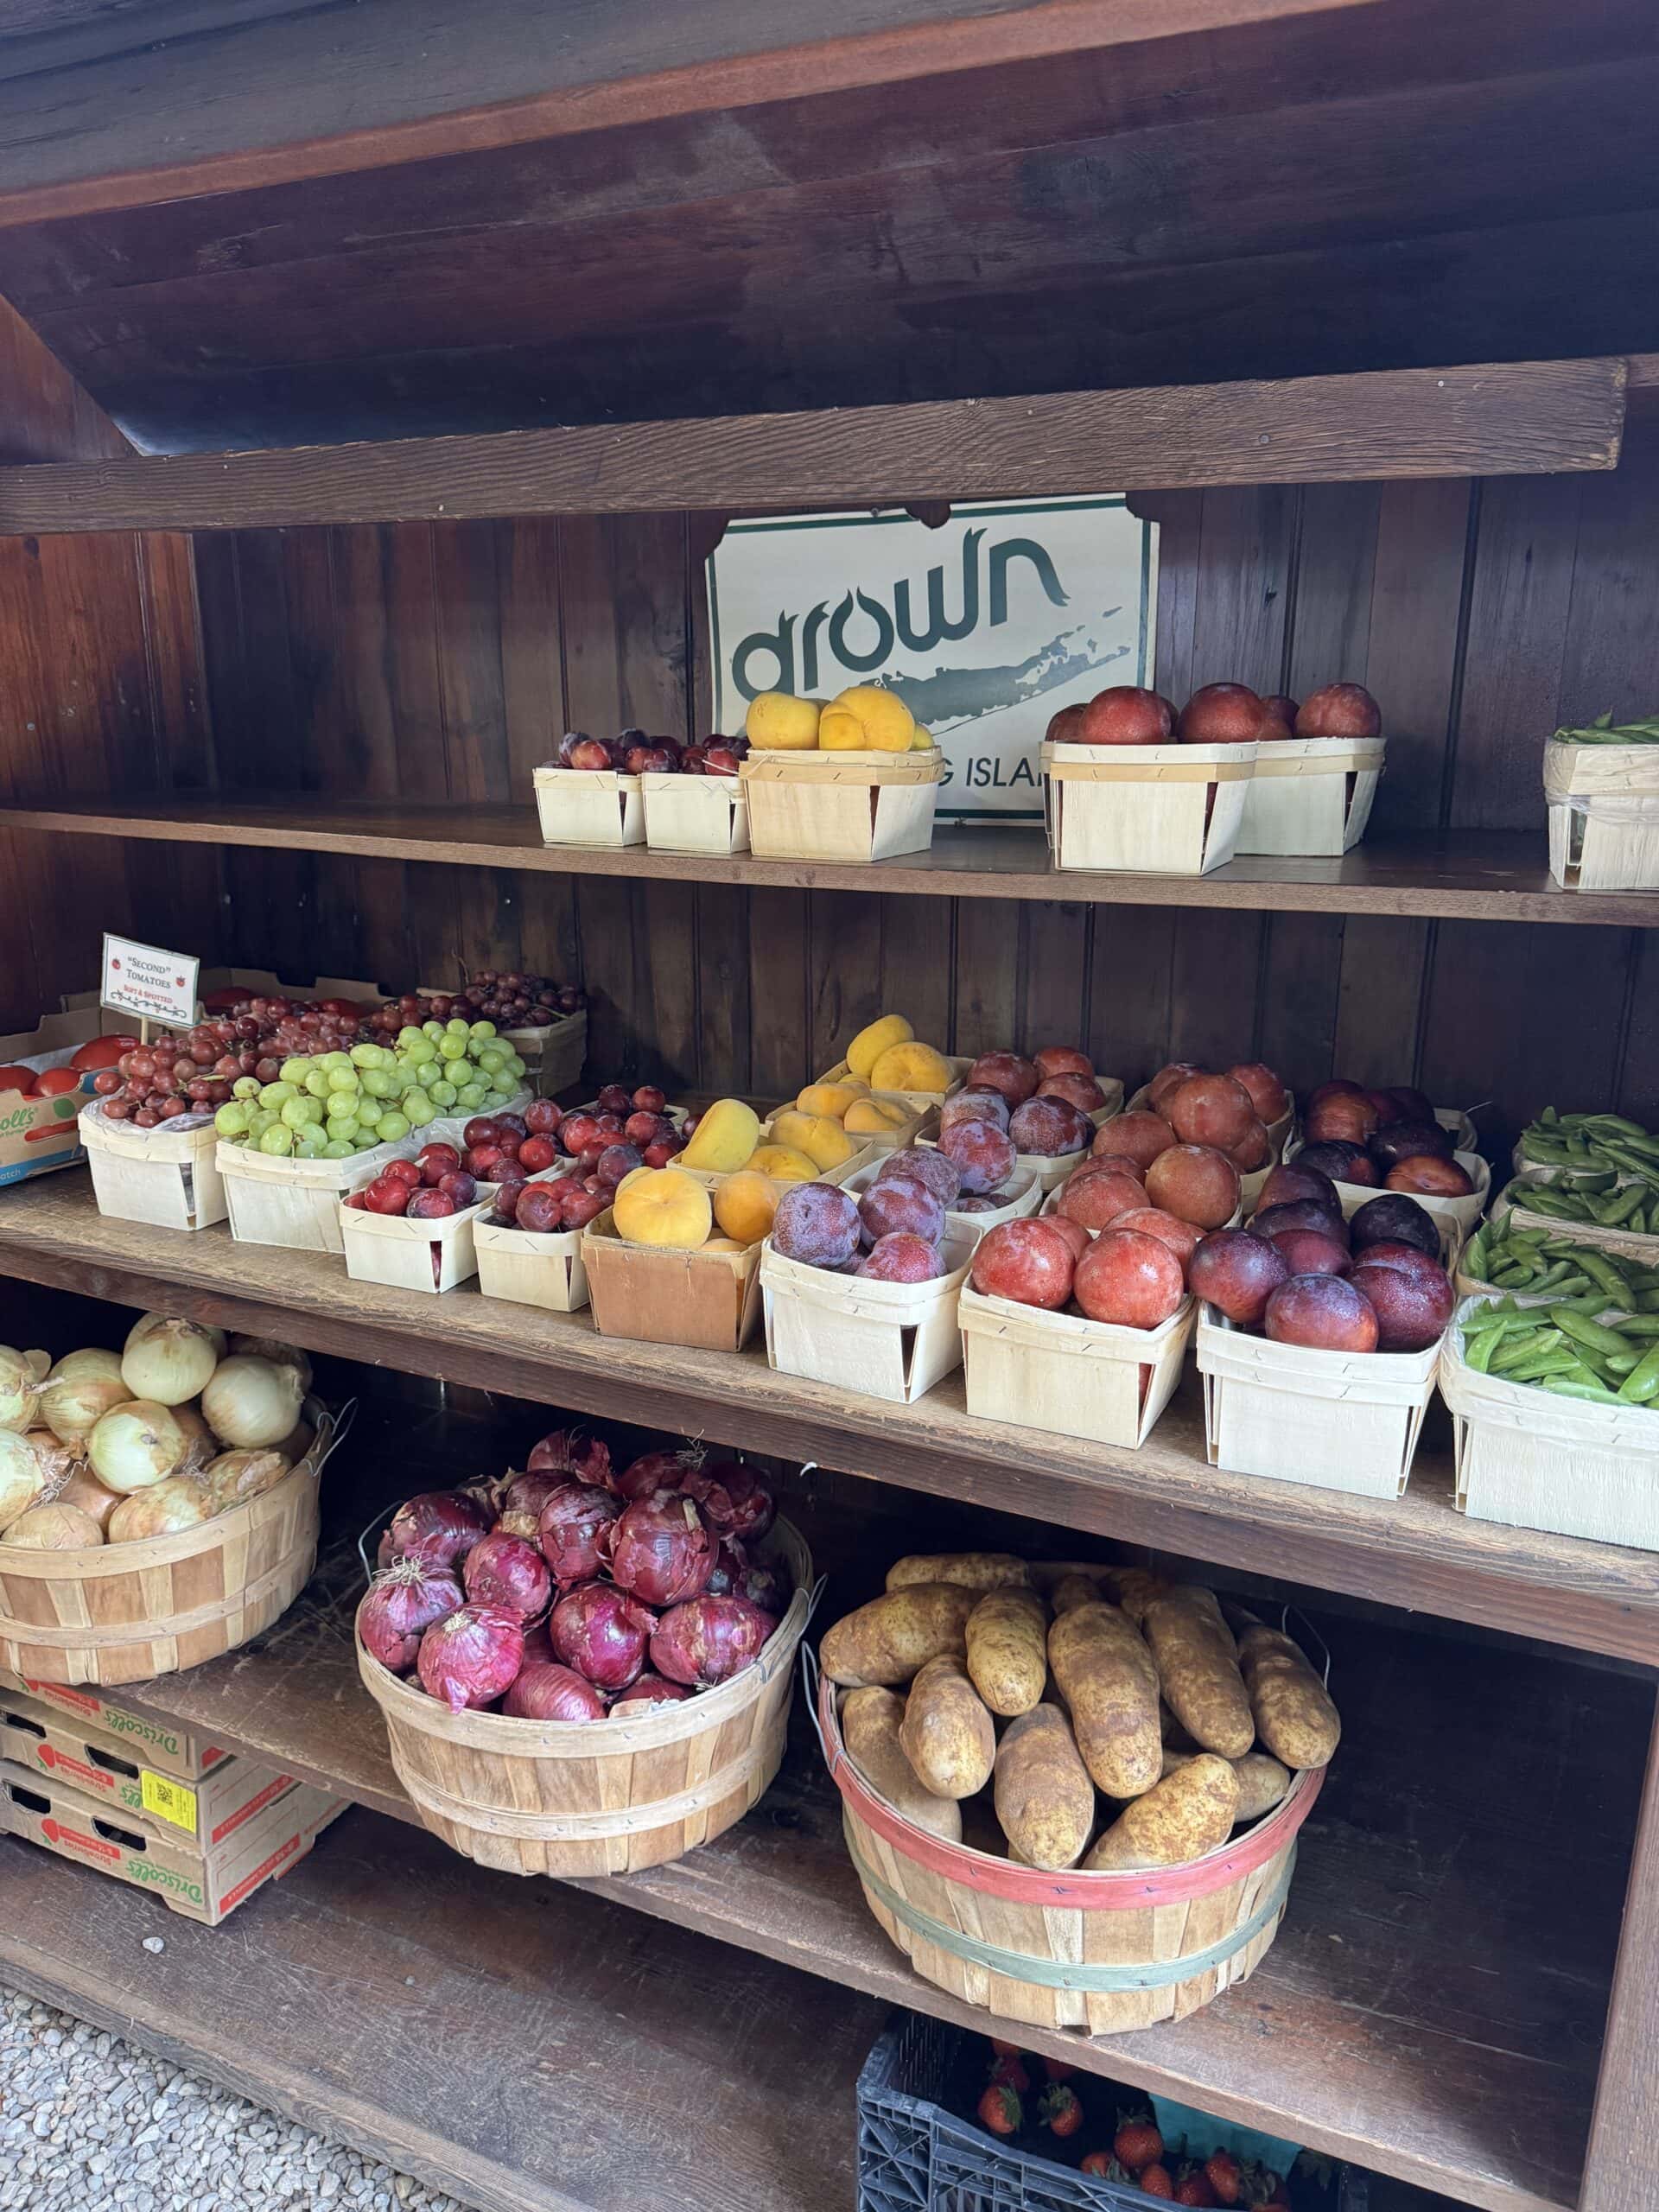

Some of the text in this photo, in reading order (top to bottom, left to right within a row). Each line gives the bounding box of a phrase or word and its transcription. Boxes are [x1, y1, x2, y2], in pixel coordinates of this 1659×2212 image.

[965, 757, 1042, 787] ISLA
[125, 968, 172, 989] TOMATOES
[0, 1107, 35, 1131] oll's
[0, 1168, 22, 1181] atch
[103, 1708, 180, 1756] Driscoll's
[124, 1858, 205, 1905] Driscoll's
